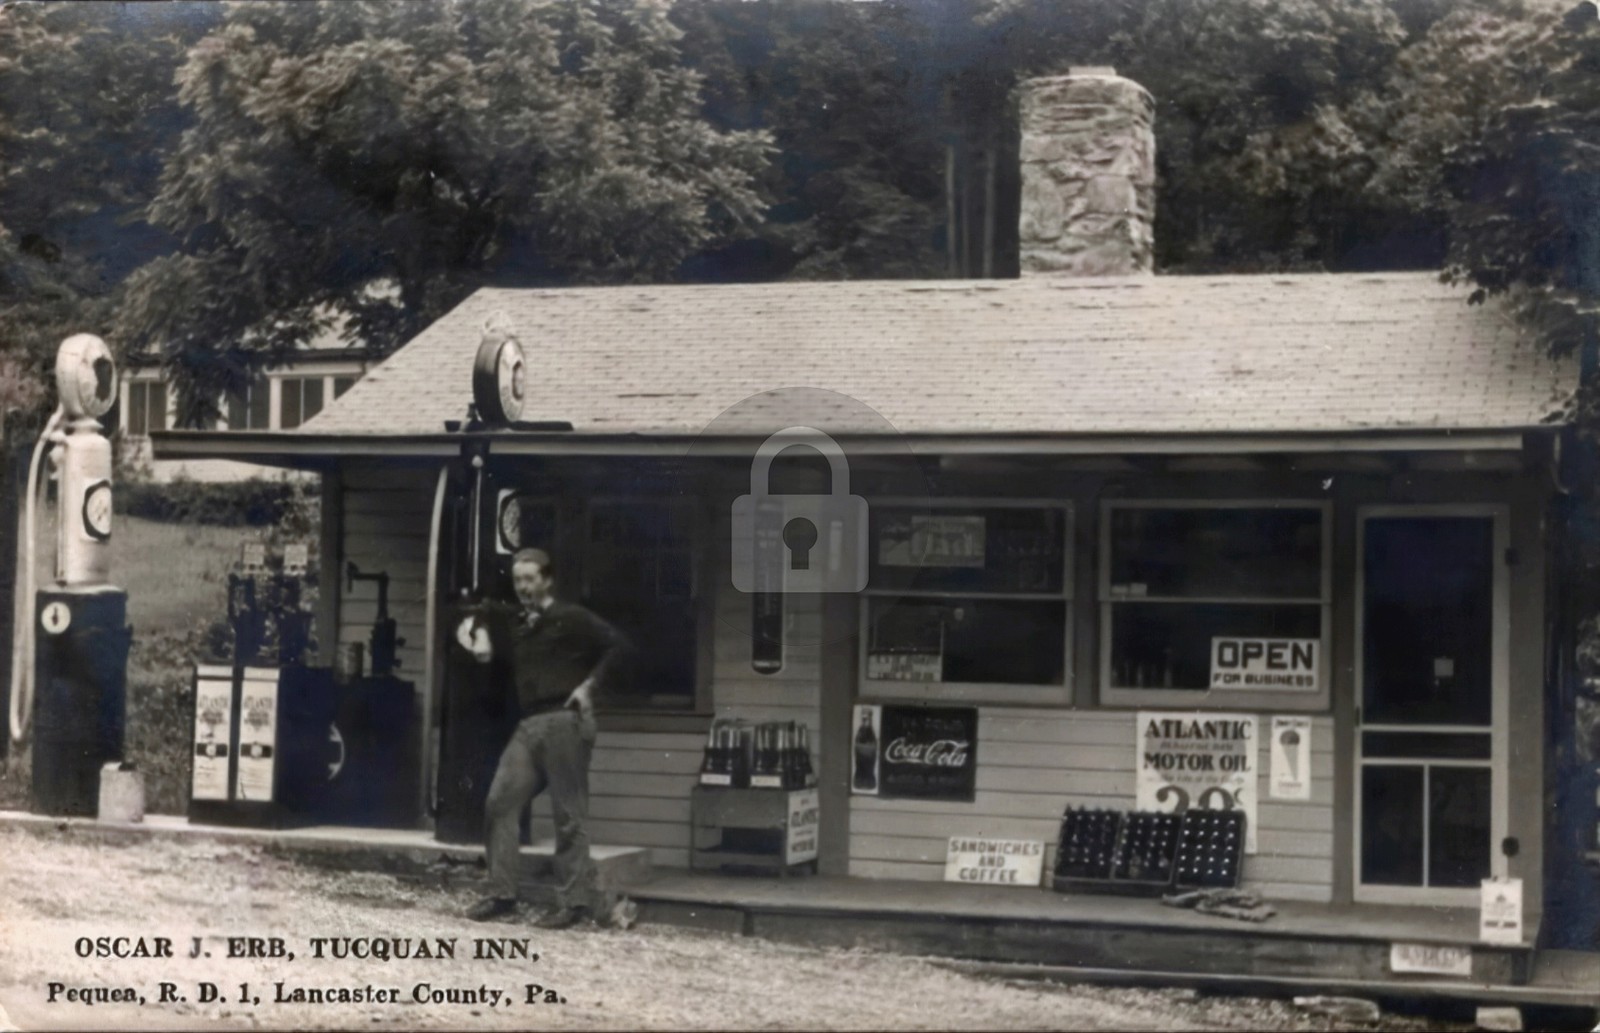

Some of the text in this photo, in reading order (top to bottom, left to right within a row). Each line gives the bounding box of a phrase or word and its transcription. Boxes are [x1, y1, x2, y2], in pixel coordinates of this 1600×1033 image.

[1217, 641, 1313, 670] OPEN
[1213, 673, 1314, 687] FOR BUSINESS
[1145, 719, 1252, 740] ATLANTIC
[1144, 753, 1251, 773] MOTOR OIL
[951, 840, 1040, 855] SANDWICHES
[978, 856, 1005, 868] AND
[958, 868, 1018, 883] COFFEE
